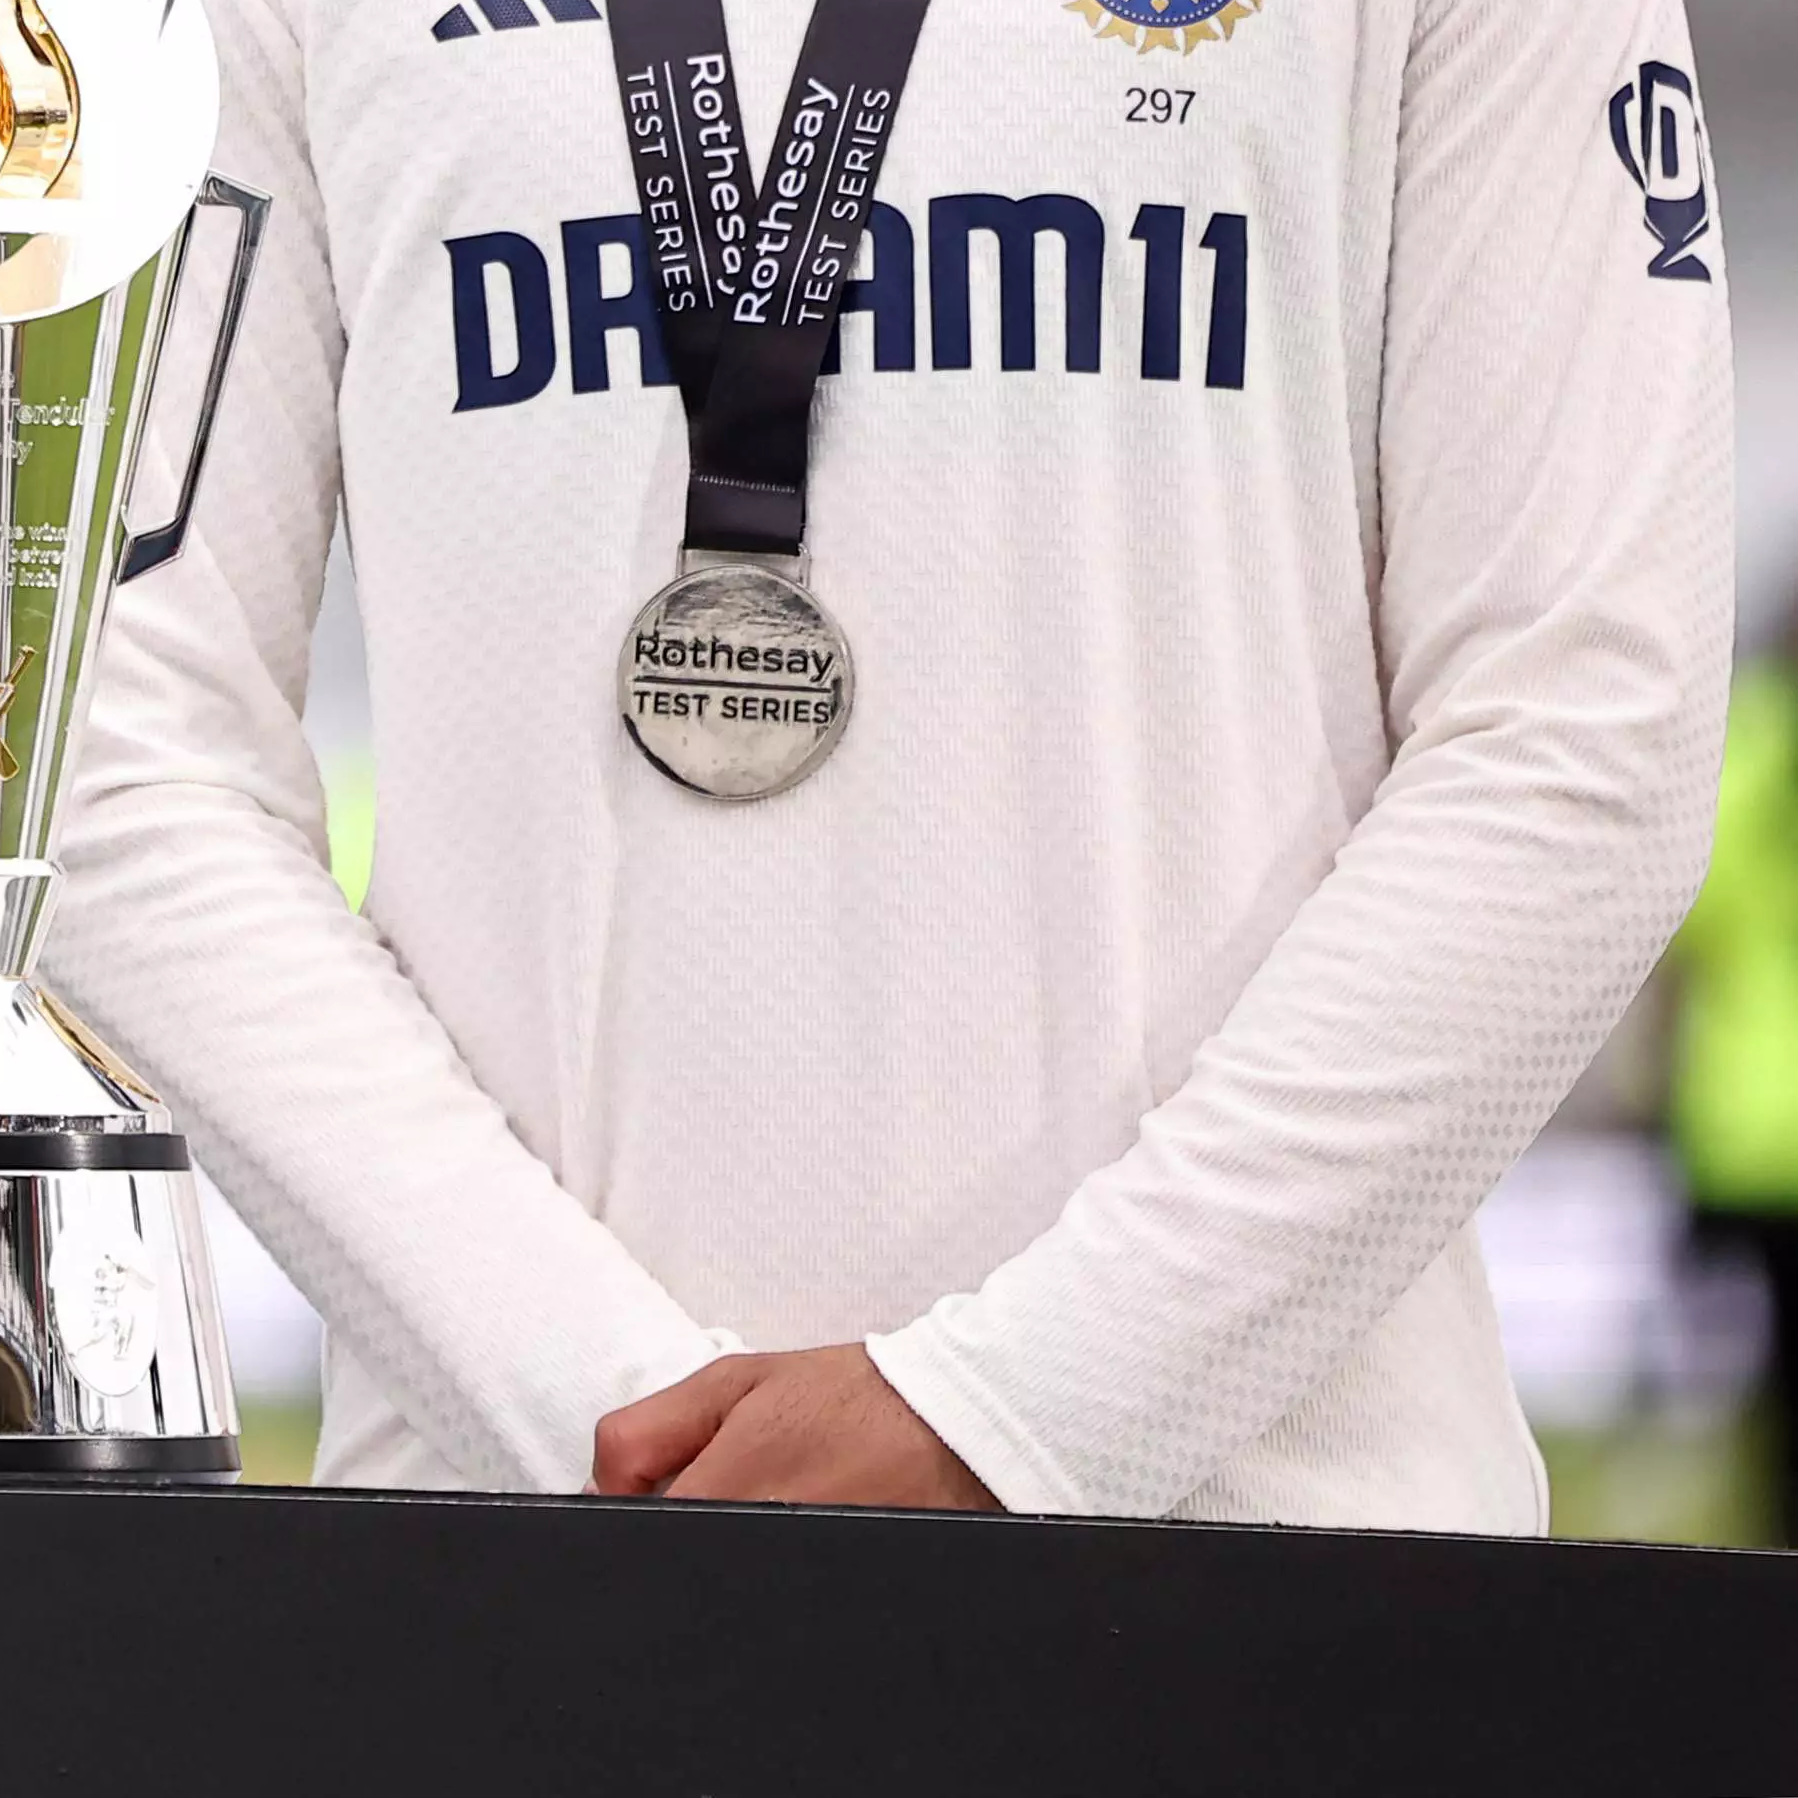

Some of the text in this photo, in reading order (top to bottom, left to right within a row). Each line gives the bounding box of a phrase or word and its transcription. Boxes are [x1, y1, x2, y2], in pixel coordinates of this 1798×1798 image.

[626, 65, 696, 312] TEST SERIES
[733, 77, 839, 324] Rothesay
[797, 88, 891, 326] TEST SERIES
[1125, 87, 1197, 125] 297
[442, 193, 1248, 414] DRAM11
[634, 631, 834, 682] Rothesay
[634, 690, 830, 724] TEST SERIES
